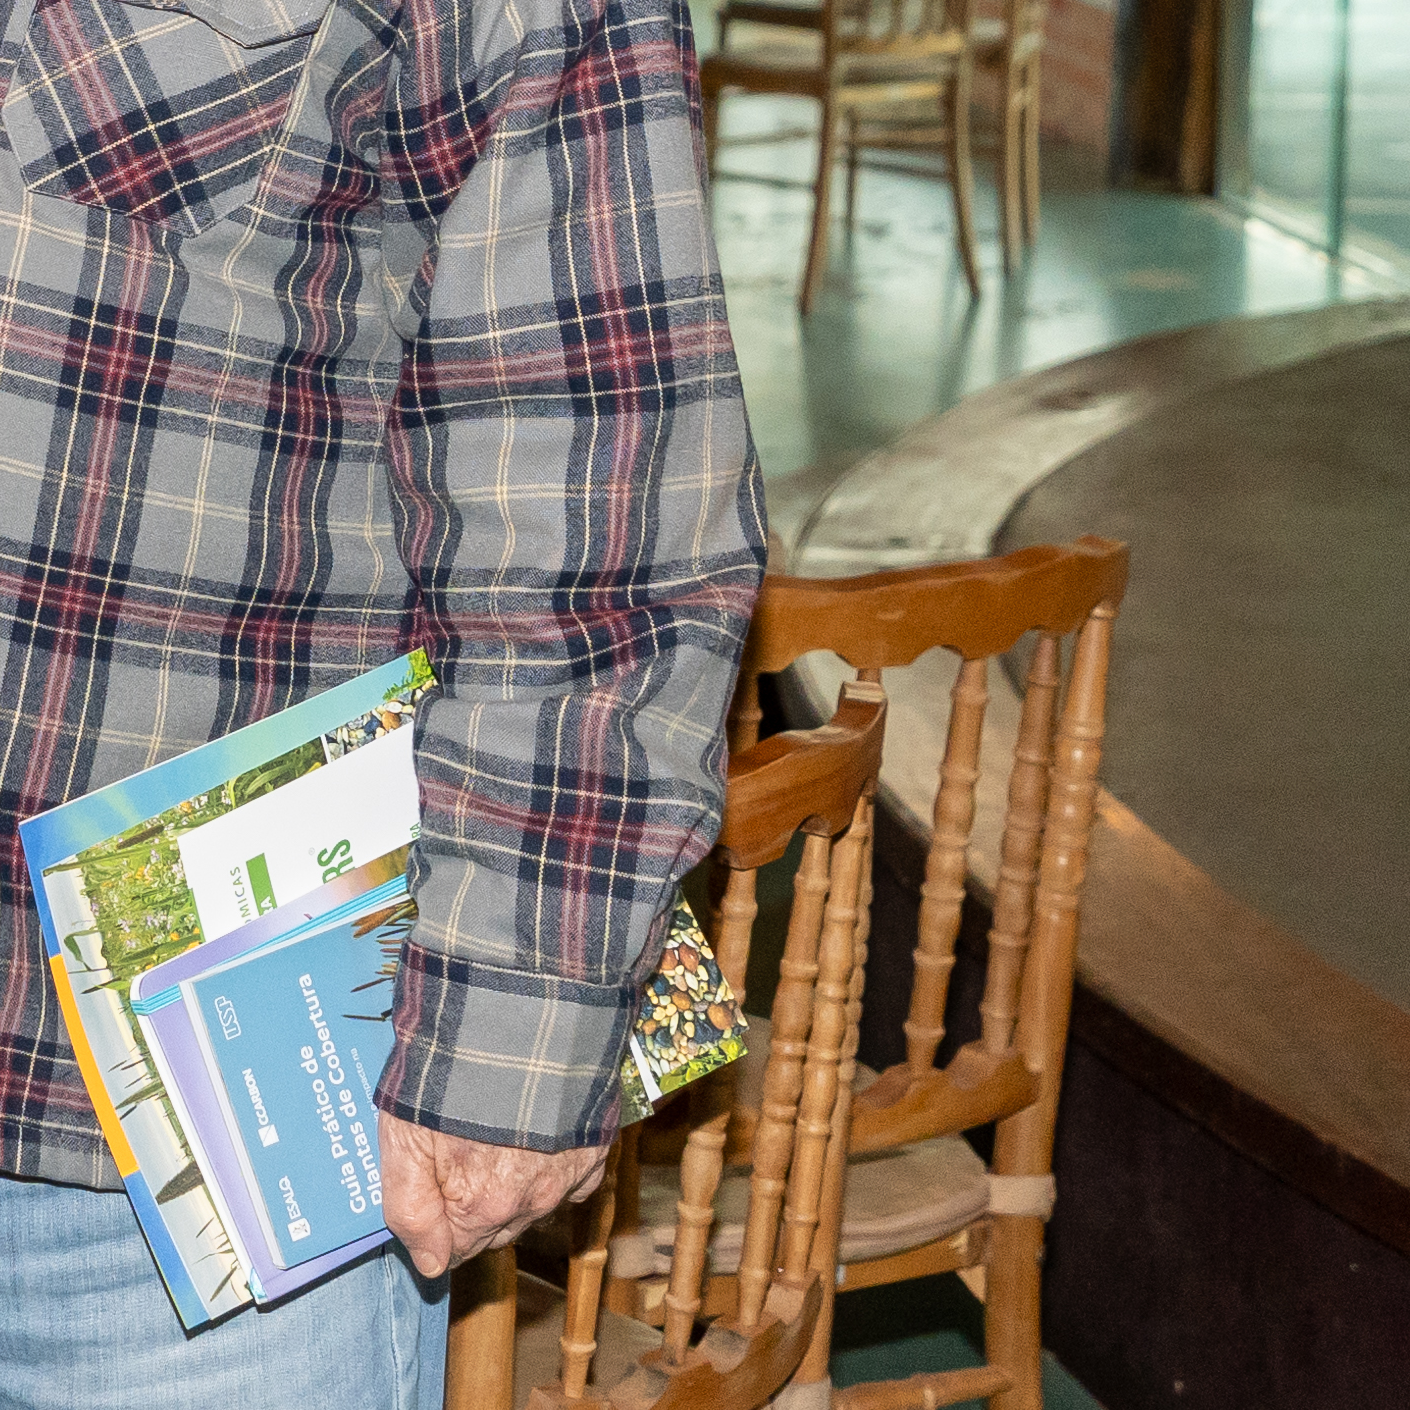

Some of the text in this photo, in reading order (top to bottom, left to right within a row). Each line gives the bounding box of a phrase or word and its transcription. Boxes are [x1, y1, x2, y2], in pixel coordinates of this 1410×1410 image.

[214, 995, 241, 1040] USP
[350, 1047, 359, 1061] na
[242, 1068, 269, 1125] CCARBON
[298, 973, 383, 1206] Plantas de Cobertura
[300, 1045, 366, 1214] Guia Prático de
[278, 1175, 301, 1220] ESALQ
